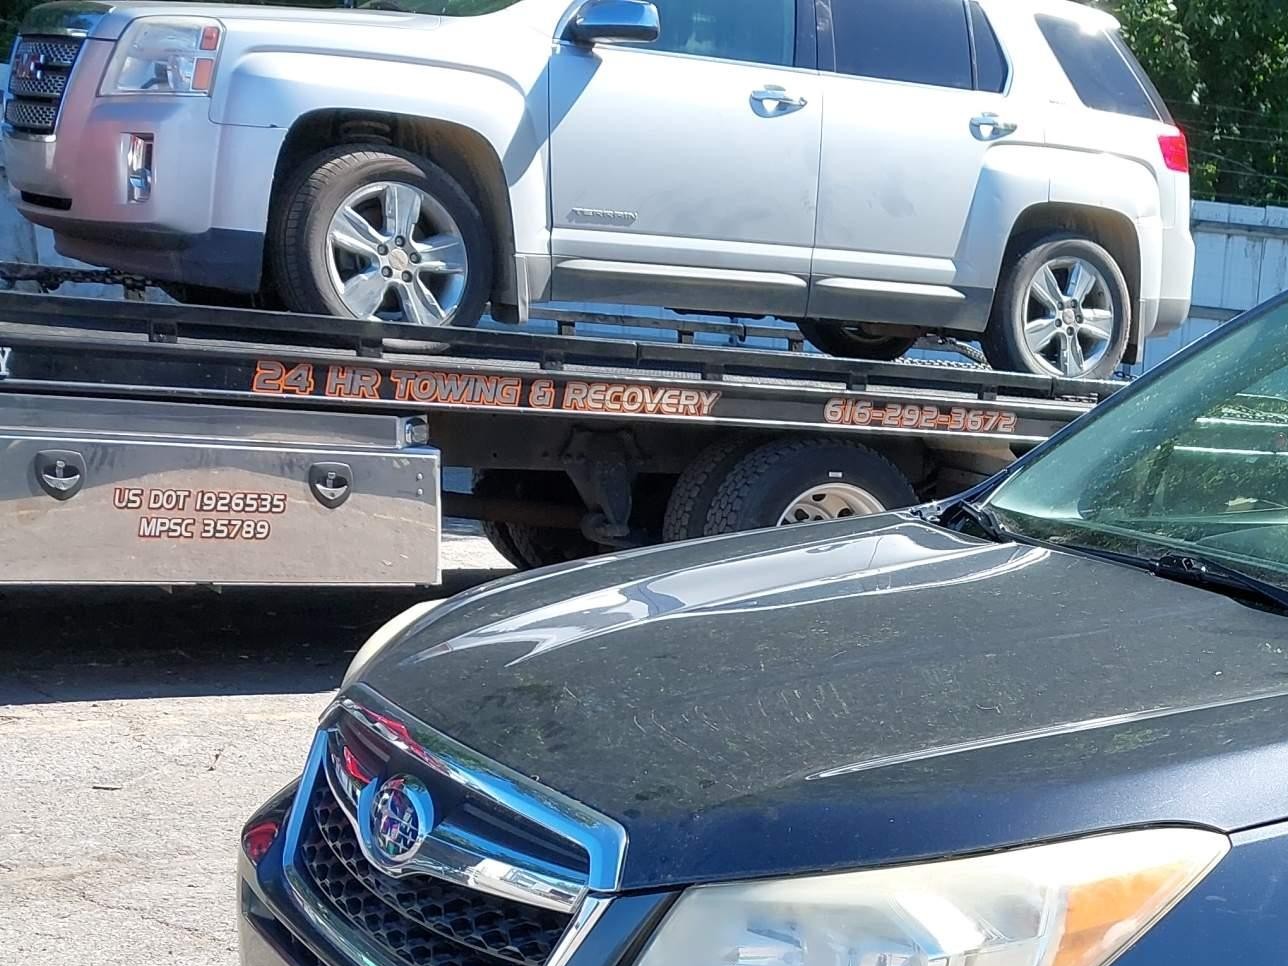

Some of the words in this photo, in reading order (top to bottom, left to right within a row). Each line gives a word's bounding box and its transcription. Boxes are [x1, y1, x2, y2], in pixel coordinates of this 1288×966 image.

[253, 360, 314, 395] 24
[325, 364, 382, 399] HR
[390, 369, 521, 406] TOWING
[529, 379, 555, 408] &
[563, 381, 721, 416] RECOVERY
[823, 397, 1018, 433] 616-292-3672
[114, 488, 142, 510] US
[149, 488, 191, 511] DOT
[195, 491, 287, 513] 1926535
[139, 517, 195, 539] MPSC
[201, 519, 270, 540] 35789
